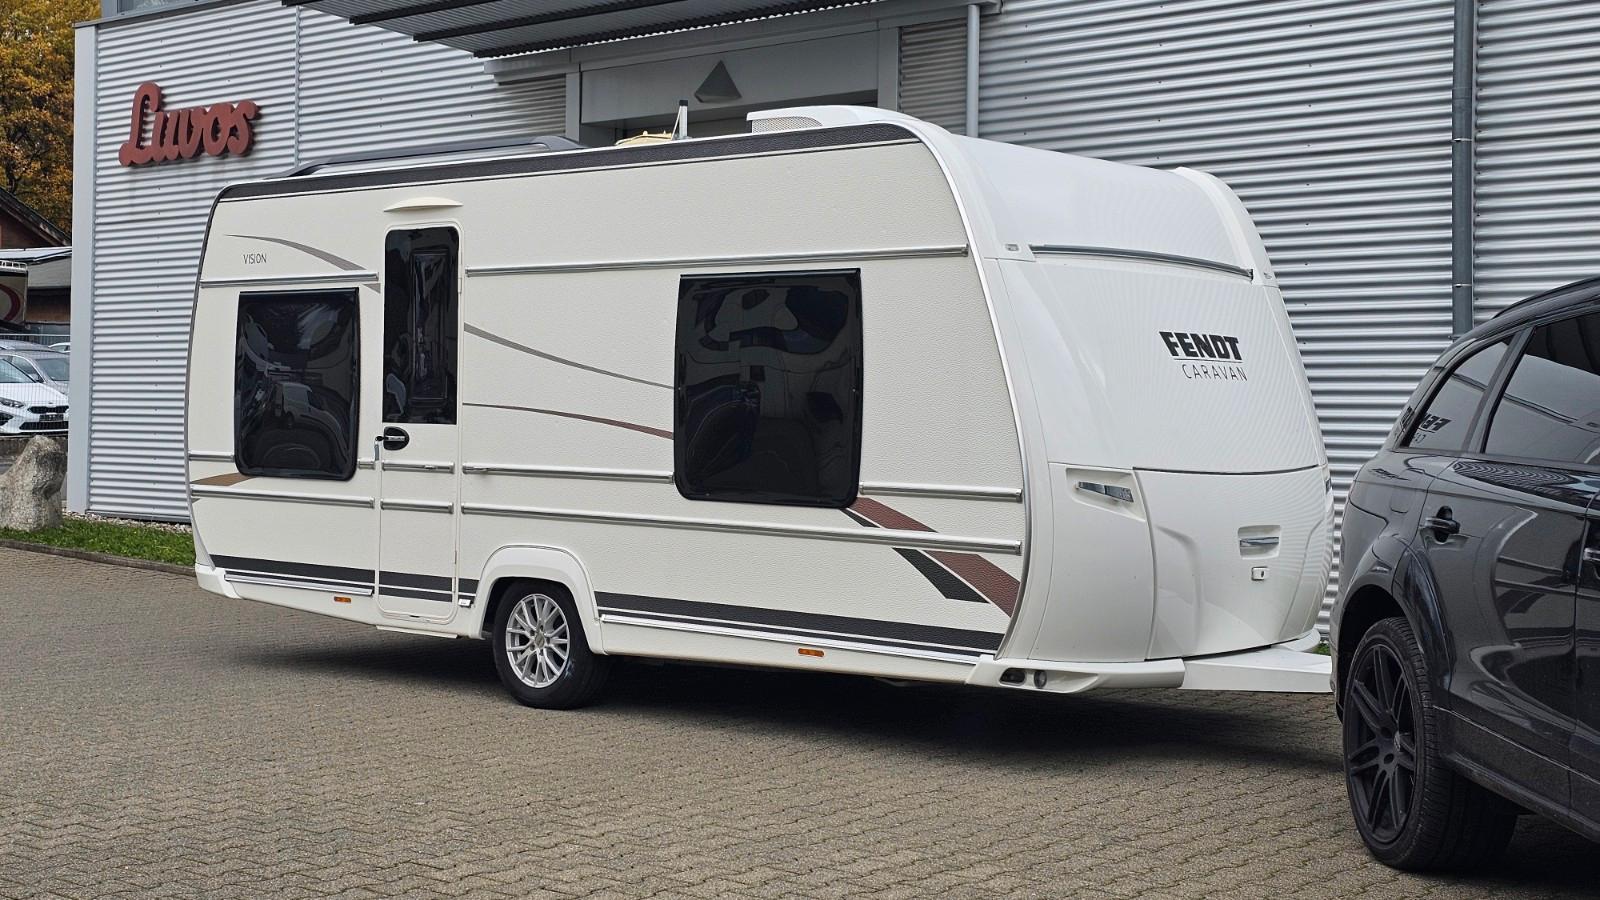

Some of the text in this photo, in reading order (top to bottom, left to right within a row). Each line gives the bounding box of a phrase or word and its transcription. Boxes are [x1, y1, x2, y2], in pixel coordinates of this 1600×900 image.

[119, 81, 258, 167] Luvos
[242, 253, 267, 265] VISION
[1159, 331, 1242, 361] FENDT
[1182, 364, 1248, 381] CARAVAN
